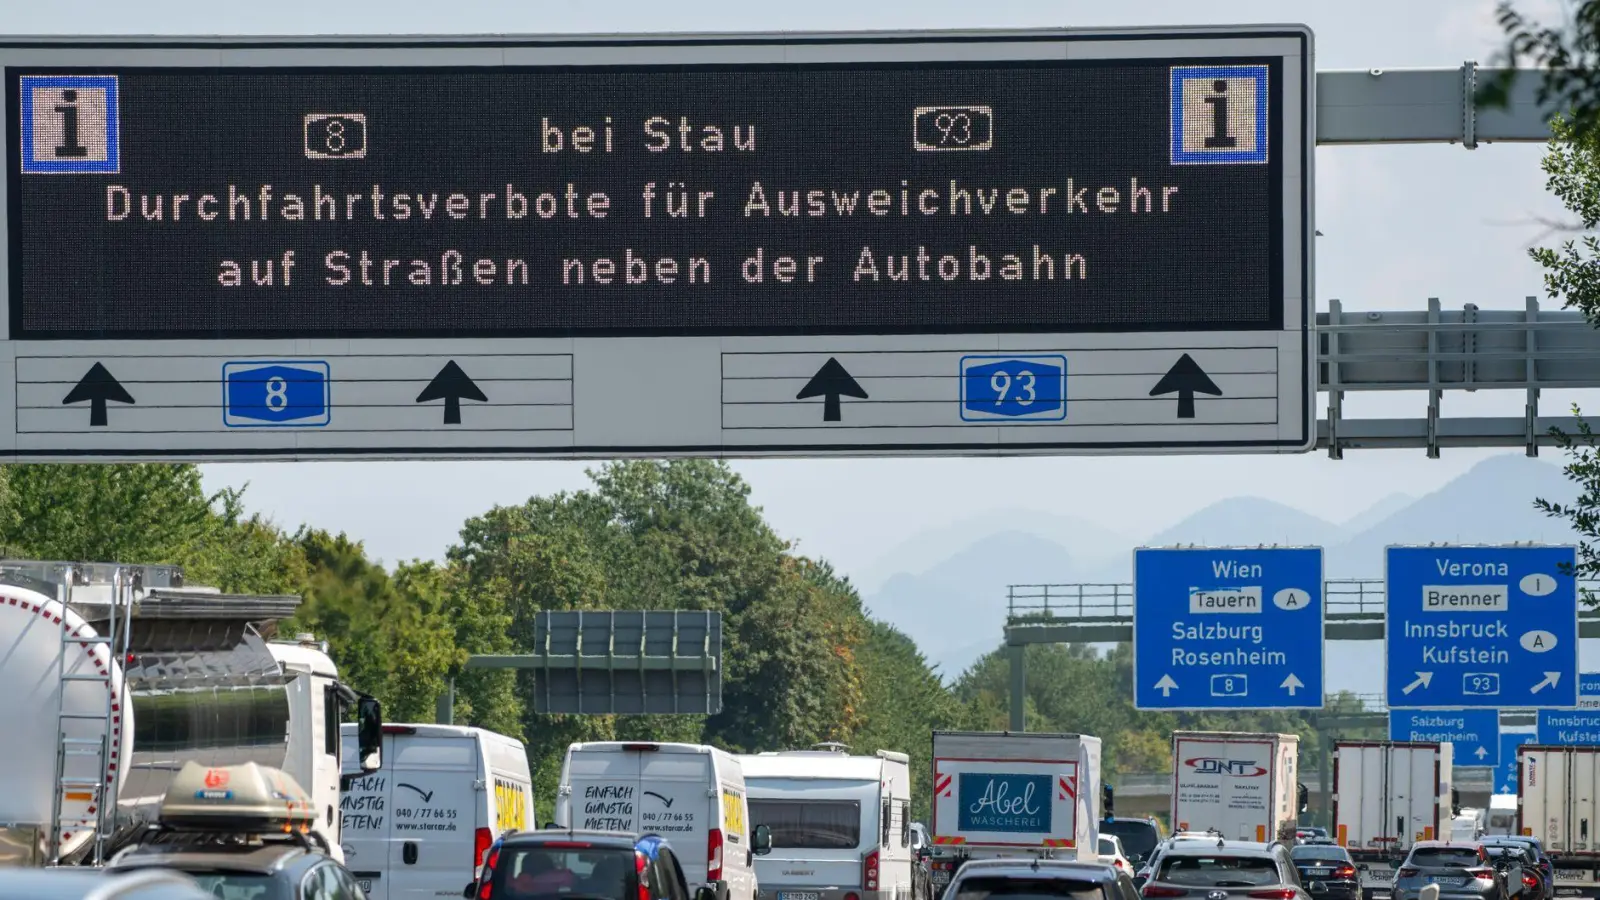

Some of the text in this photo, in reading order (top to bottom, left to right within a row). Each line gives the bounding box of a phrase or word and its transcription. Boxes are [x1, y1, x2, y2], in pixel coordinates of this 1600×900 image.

[326, 121, 345, 151] 8
[542, 116, 755, 153] bei Stau
[935, 113, 971, 144] 93
[107, 177, 1179, 221] Durchfahrtsverbote für Ausweichverkehr
[217, 244, 1088, 287] auf Straßen neben der Autobahn
[265, 376, 288, 412] 8
[990, 370, 1036, 406] 93
[1212, 560, 1262, 578] Wien
[1435, 558, 1509, 577] Verona
[1196, 592, 1256, 608] Tauern
[1286, 592, 1298, 606] A
[1428, 590, 1502, 606] Brenner
[1172, 621, 1263, 644] Salzburg
[1405, 619, 1509, 638] Innsbruck
[1533, 634, 1544, 648] A
[1172, 647, 1286, 666] Rosenheim
[1422, 645, 1509, 664] Kufstein
[1224, 678, 1234, 692] 8
[1472, 676, 1490, 691] 93
[1580, 682, 1600, 691] ron
[1411, 715, 1465, 729] Salzburg
[1547, 714, 1600, 727] Innsbruc
[1410, 730, 1478, 742] Rosenheim
[1558, 730, 1600, 743] Kufstei
[1193, 759, 1257, 775] DNT
[969, 778, 1040, 815] Abel
[396, 808, 411, 818] 040
[420, 808, 431, 818] 77
[434, 809, 444, 818] 66
[447, 809, 457, 818] 55
[643, 813, 656, 821] 040
[663, 813, 672, 821] 77
[674, 813, 683, 821] 66
[684, 813, 694, 821] 55
[970, 814, 1040, 827] WÄSCHEREI
[396, 822, 457, 832] www.starcar.de
[643, 823, 693, 832] www.starcar.de
